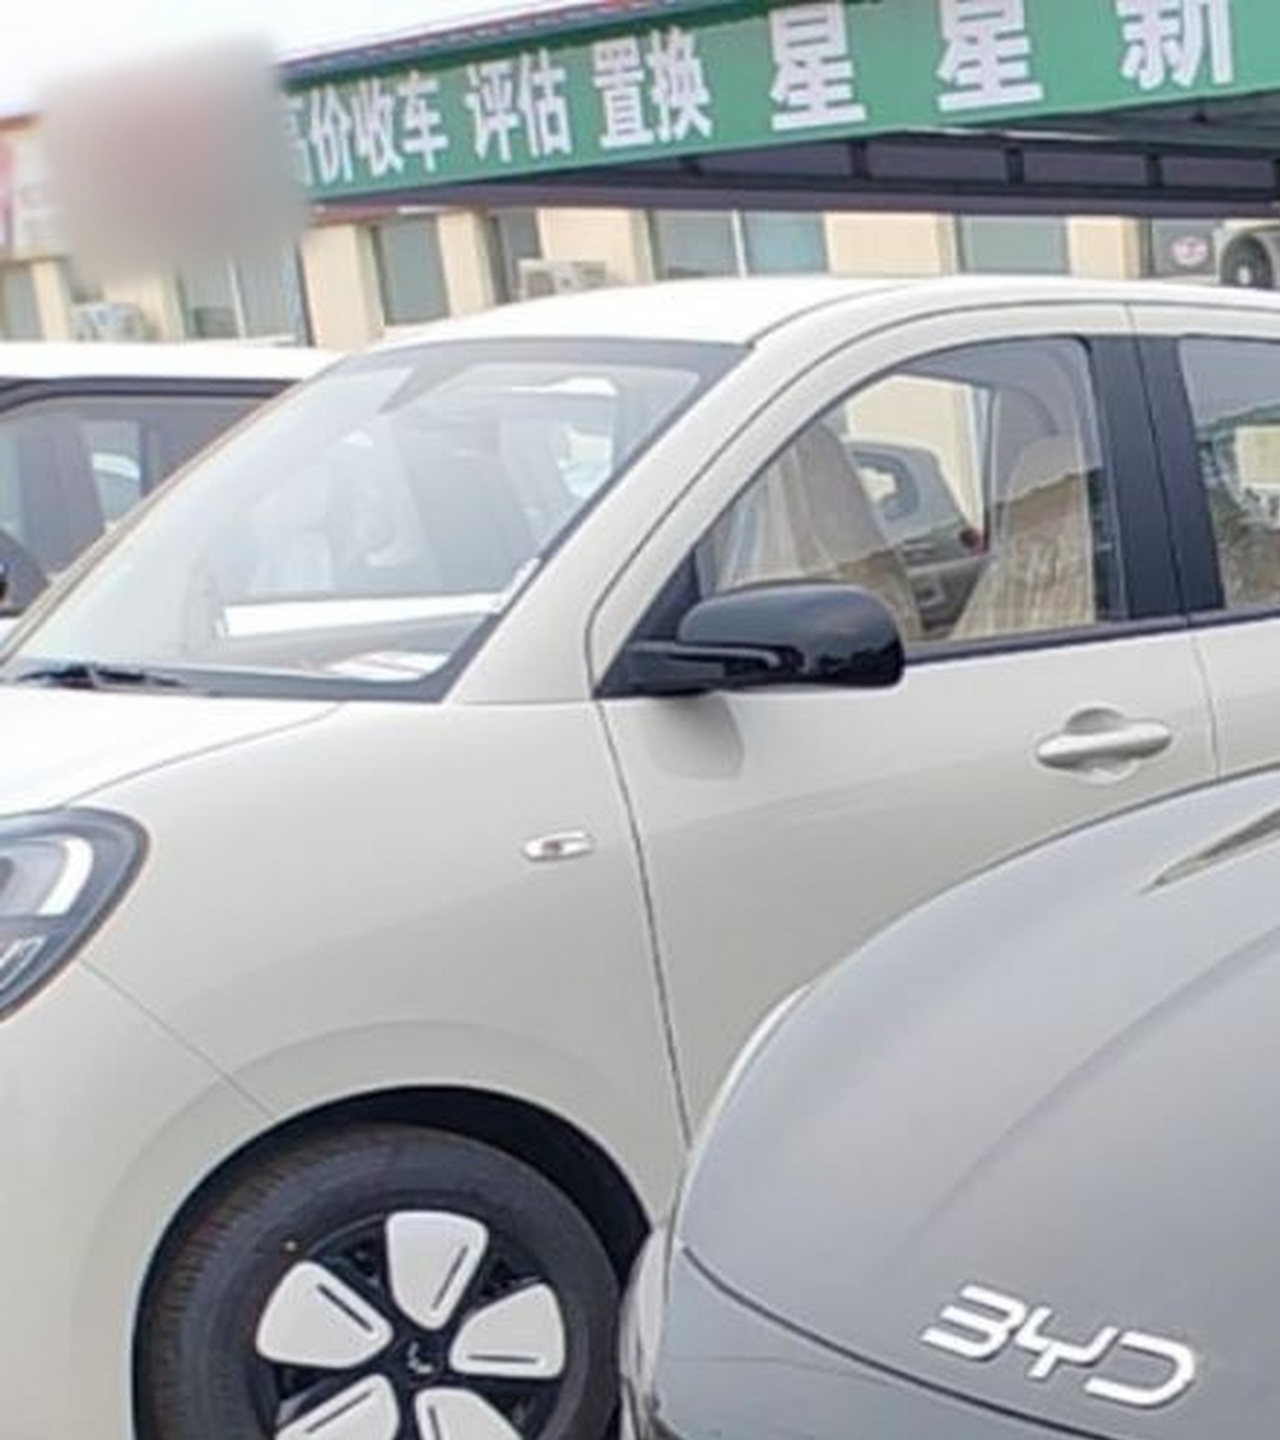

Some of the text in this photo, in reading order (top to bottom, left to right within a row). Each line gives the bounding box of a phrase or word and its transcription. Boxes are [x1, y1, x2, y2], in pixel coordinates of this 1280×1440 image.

[465, 50, 572, 163] 评估
[593, 29, 712, 149] 置换
[919, 1283, 1196, 1408] BYD
